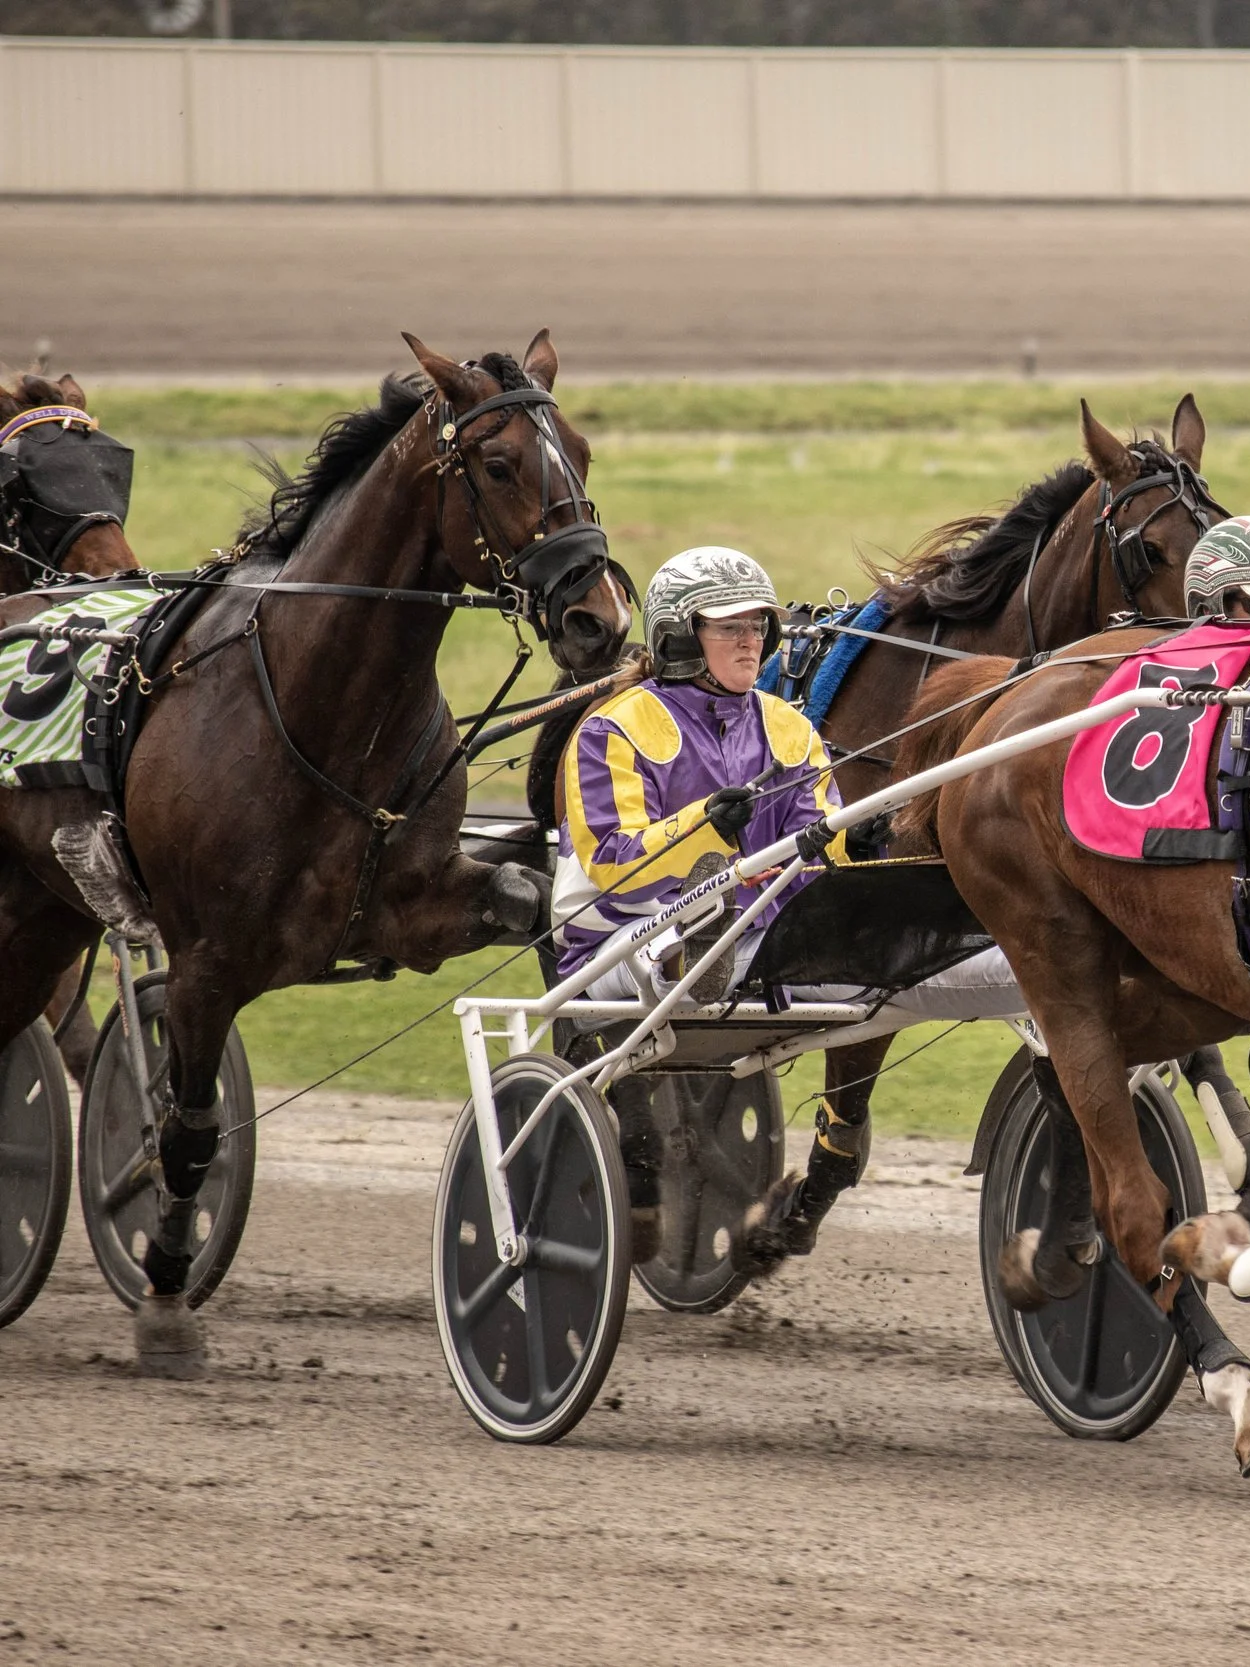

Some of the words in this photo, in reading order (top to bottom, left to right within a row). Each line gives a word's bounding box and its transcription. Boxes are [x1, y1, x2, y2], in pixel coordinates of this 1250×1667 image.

[2, 613, 109, 723] 9
[1102, 660, 1220, 810] 8
[630, 917, 658, 942] KATE
[660, 870, 731, 922] HARGREAVES
